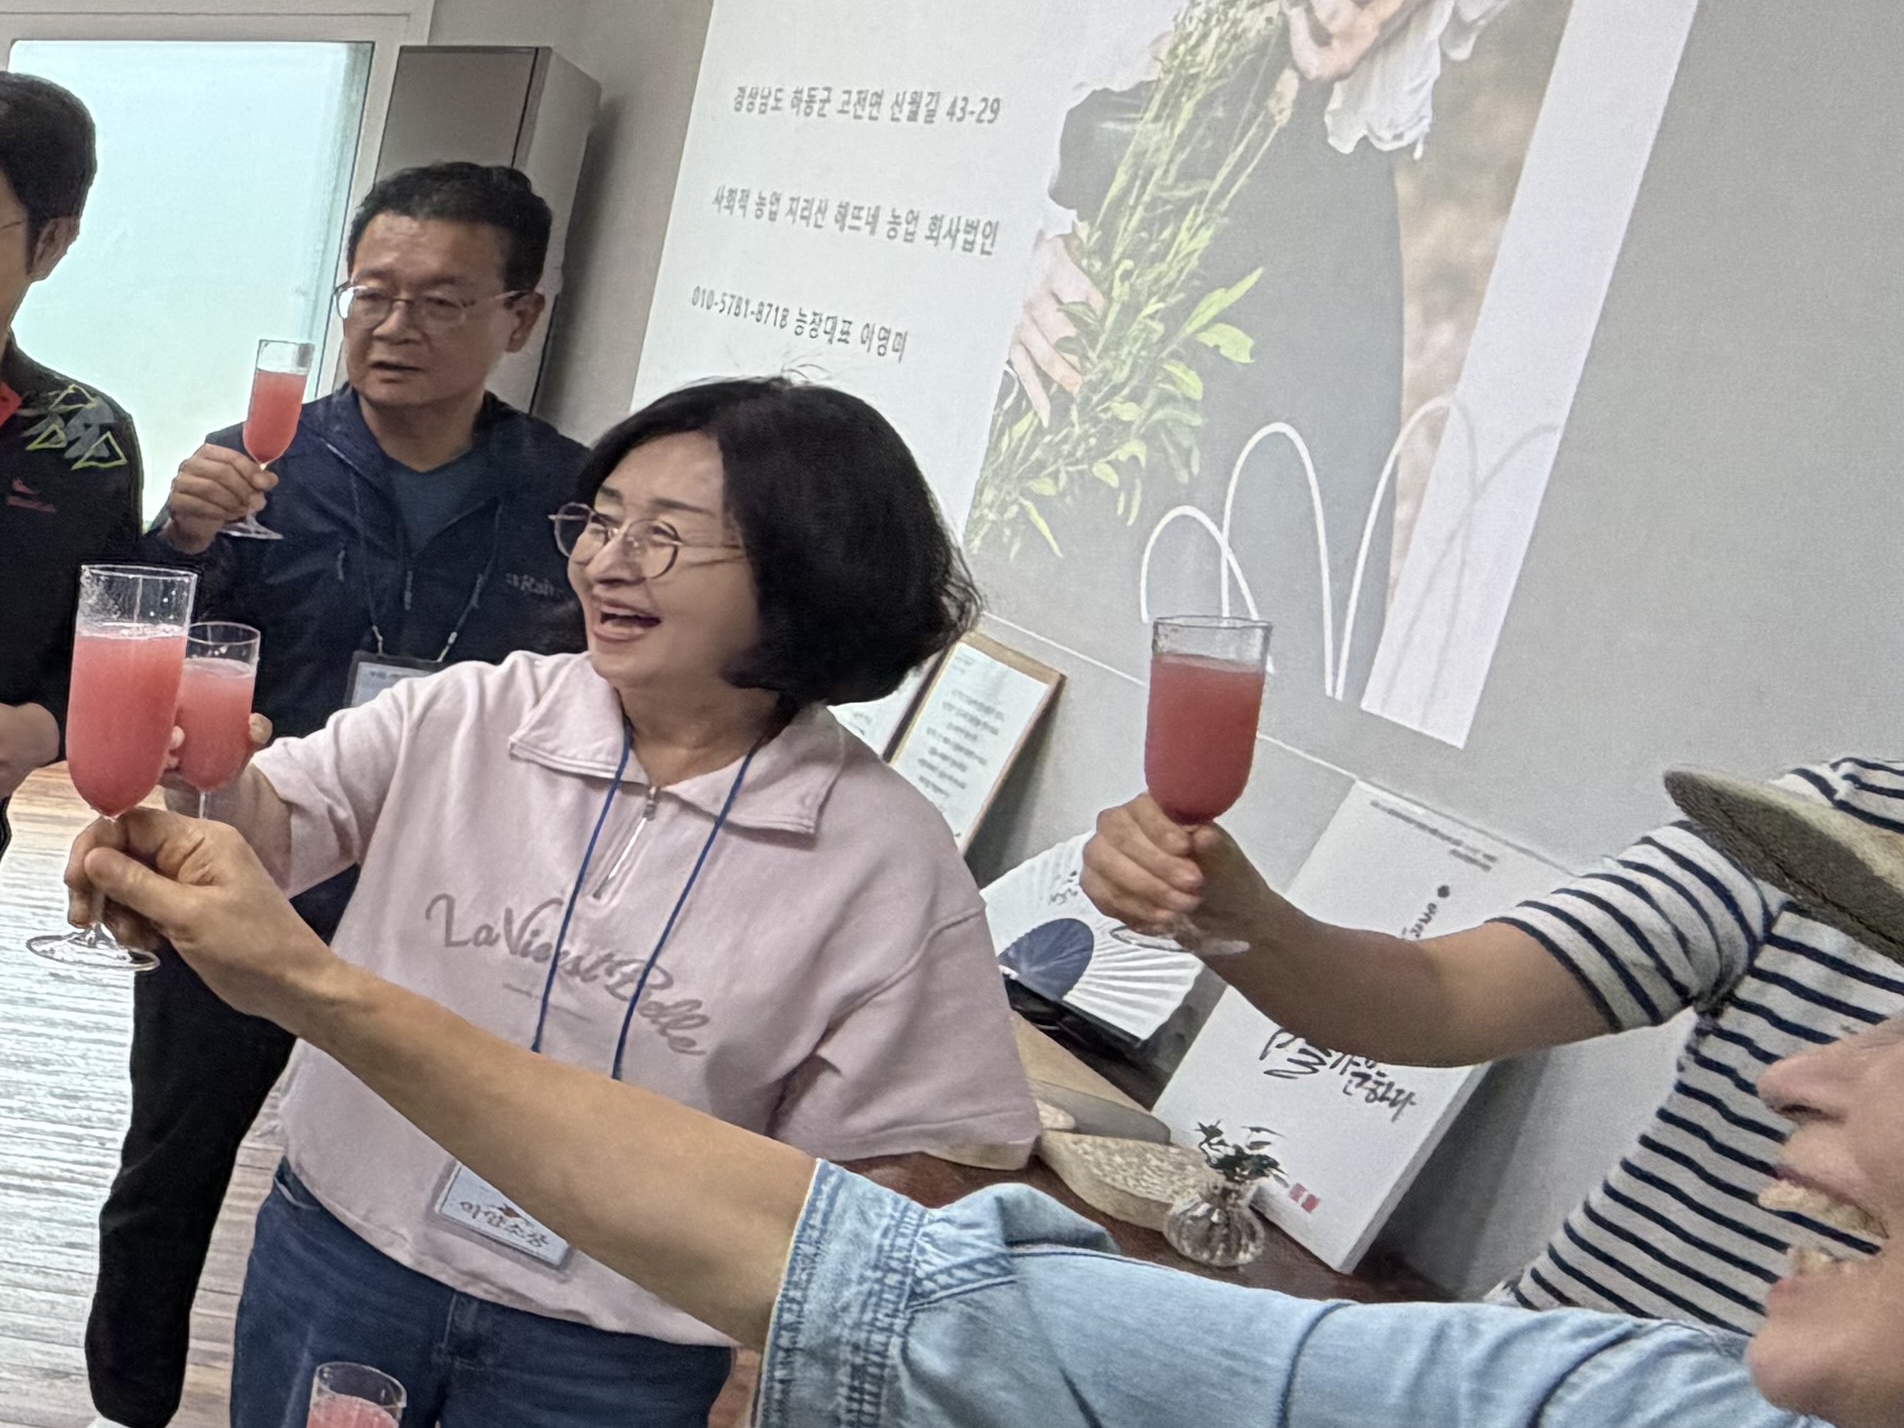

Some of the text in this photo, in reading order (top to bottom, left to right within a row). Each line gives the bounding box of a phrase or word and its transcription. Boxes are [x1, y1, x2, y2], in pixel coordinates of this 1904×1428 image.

[733, 85, 785, 115] 경상남도
[791, 85, 833, 118] 하동군
[836, 88, 885, 121] 고전면
[945, 95, 1002, 125] 43-29
[711, 184, 752, 219] 사회적
[754, 190, 783, 223] 농업
[784, 195, 830, 230] 지리산
[886, 207, 921, 244] 농업
[924, 213, 1001, 257] 회사법인
[793, 307, 854, 345] 농장대표
